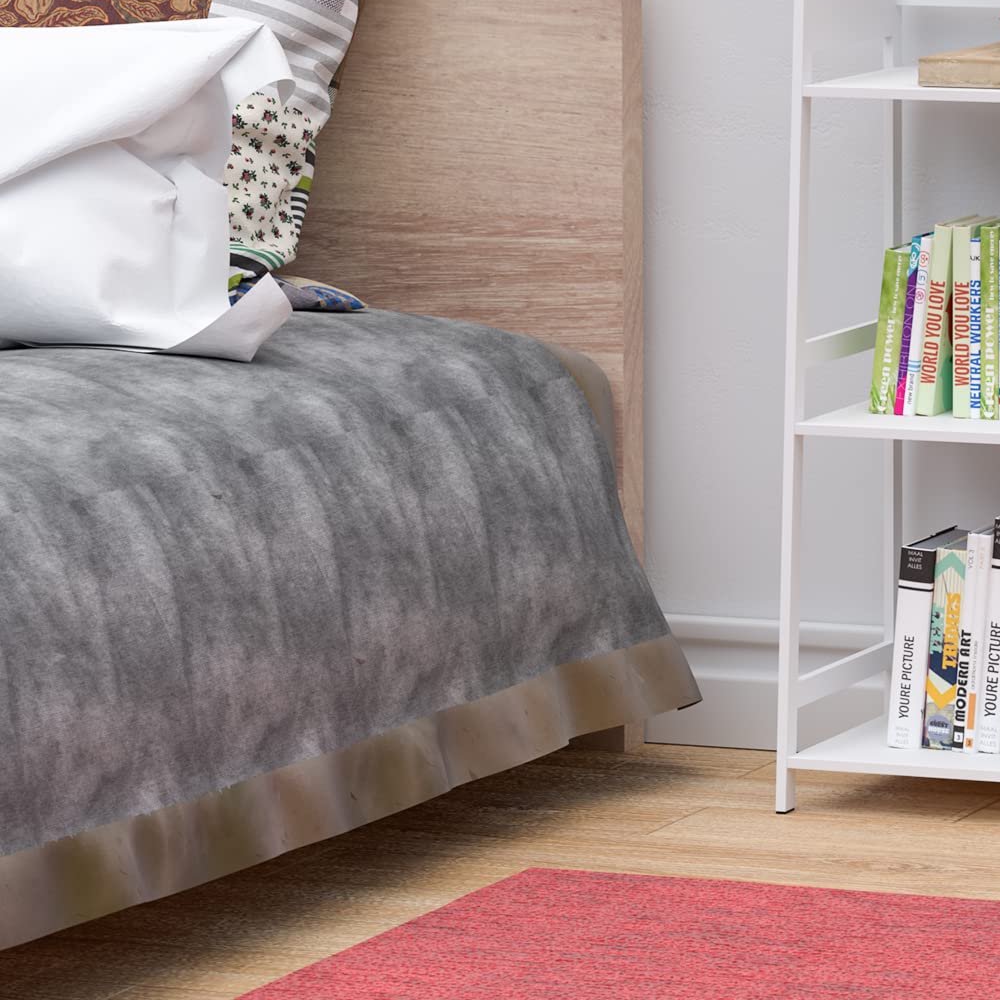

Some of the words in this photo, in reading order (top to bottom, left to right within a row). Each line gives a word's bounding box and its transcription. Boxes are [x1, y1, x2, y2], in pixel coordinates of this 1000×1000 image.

[928, 280, 946, 310] LOVE
[954, 281, 970, 311] LOVE
[970, 280, 981, 344] WORKERS
[925, 312, 942, 338] YOU
[954, 314, 970, 340] YOU
[920, 341, 939, 383] WORLD
[954, 343, 970, 386] WORLD
[970, 350, 981, 409] NEUTRAL
[901, 635, 915, 681] PICTURE
[959, 629, 972, 657] ART
[898, 683, 911, 719] YOURE
[984, 676, 999, 717] YOURE
